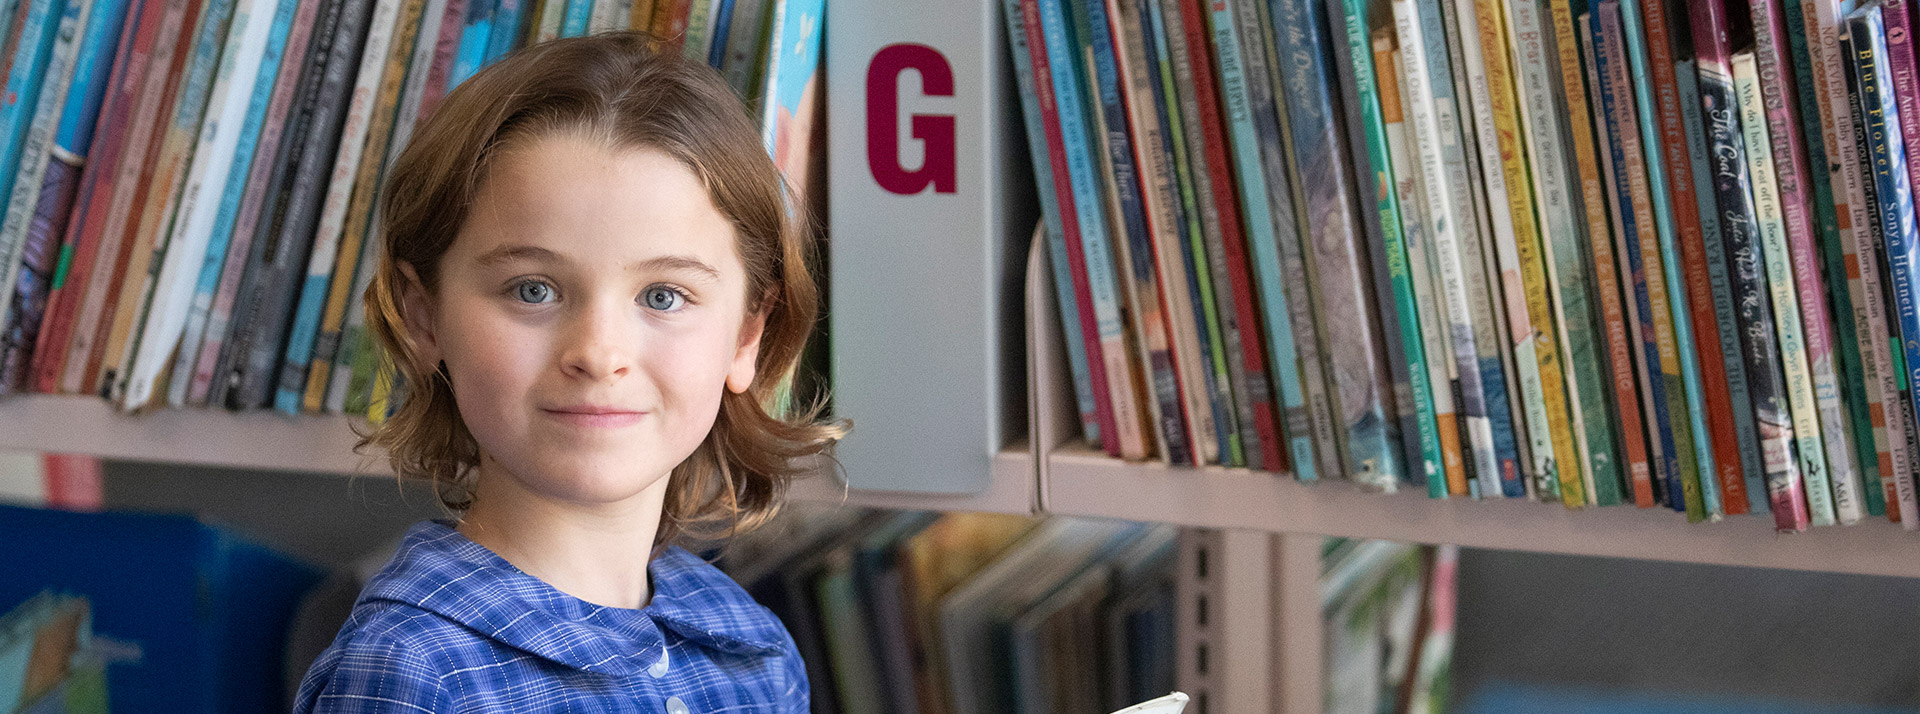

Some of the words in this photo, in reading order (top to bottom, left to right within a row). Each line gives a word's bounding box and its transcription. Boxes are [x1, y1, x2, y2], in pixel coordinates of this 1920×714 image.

[1397, 15, 1412, 39] The
[1820, 26, 1835, 49] NO!
[1402, 42, 1418, 73] Wild
[1519, 30, 1543, 66] Bear
[1605, 22, 1624, 82] JACQUELINE
[1616, 85, 1631, 123] HARVEY
[1804, 2, 1820, 44] CLANCY
[1814, 60, 1834, 129] COURAGEOUS
[1826, 132, 1839, 156] COW
[1826, 53, 1844, 99] NEVER!
[1896, 67, 1911, 89] The
[1409, 76, 1423, 103] One
[1741, 82, 1755, 106] Why
[867, 42, 957, 195] G
[1659, 82, 1678, 138] TERRIBLE
[1710, 106, 1733, 139] The
[1746, 108, 1758, 122] do
[1849, 91, 1861, 125] WHERE
[1858, 49, 1878, 93] Blue
[1868, 108, 1892, 177] Flower
[1900, 93, 1918, 134] Aussie
[1750, 130, 1763, 154] have
[1835, 114, 1851, 141] Libby
[1854, 126, 1864, 140] DO
[1414, 111, 1432, 149] Sonya
[1424, 153, 1443, 209] Hartnett
[1626, 137, 1638, 157] THE
[1714, 141, 1741, 180] Coat
[1755, 156, 1766, 167] to
[1857, 141, 1867, 161] YOU
[1757, 168, 1768, 184] eat
[1842, 144, 1859, 188] Hathorn
[1760, 186, 1772, 201] off
[1850, 191, 1859, 205] and
[1866, 194, 1878, 222] LITTLE
[1763, 202, 1775, 220] the
[1787, 203, 1802, 237] HUNT
[1852, 207, 1866, 227] Lisa
[1702, 218, 1720, 265] RANG
[1766, 221, 1781, 252] floor?
[1871, 224, 1882, 249] ONE?
[1771, 260, 1787, 287] Chris
[1795, 249, 1810, 280] MOSS
[1856, 229, 1881, 317] Hathorn-Jarman
[1881, 201, 1904, 246] Sonya
[1893, 254, 1916, 317] Hartnett
[1710, 269, 1736, 358] DOORBELL
[1775, 289, 1793, 331] Hornsey
[1802, 289, 1821, 348] CHAPMAN
[1784, 341, 1801, 371] Gwyn
[1855, 306, 1871, 345] LACHIE
[1863, 350, 1877, 380] HUME
[1726, 362, 1743, 394] THE
[1792, 373, 1808, 409] Perkins
[1882, 375, 1893, 392] Mel
[1409, 361, 1427, 408] WALKER
[1418, 411, 1435, 451] BOOKS
[1885, 396, 1900, 430] Pearce
[1722, 462, 1738, 496] A&U
[1893, 446, 1912, 501] LOTHIAN
[1834, 479, 1849, 508] A&U
